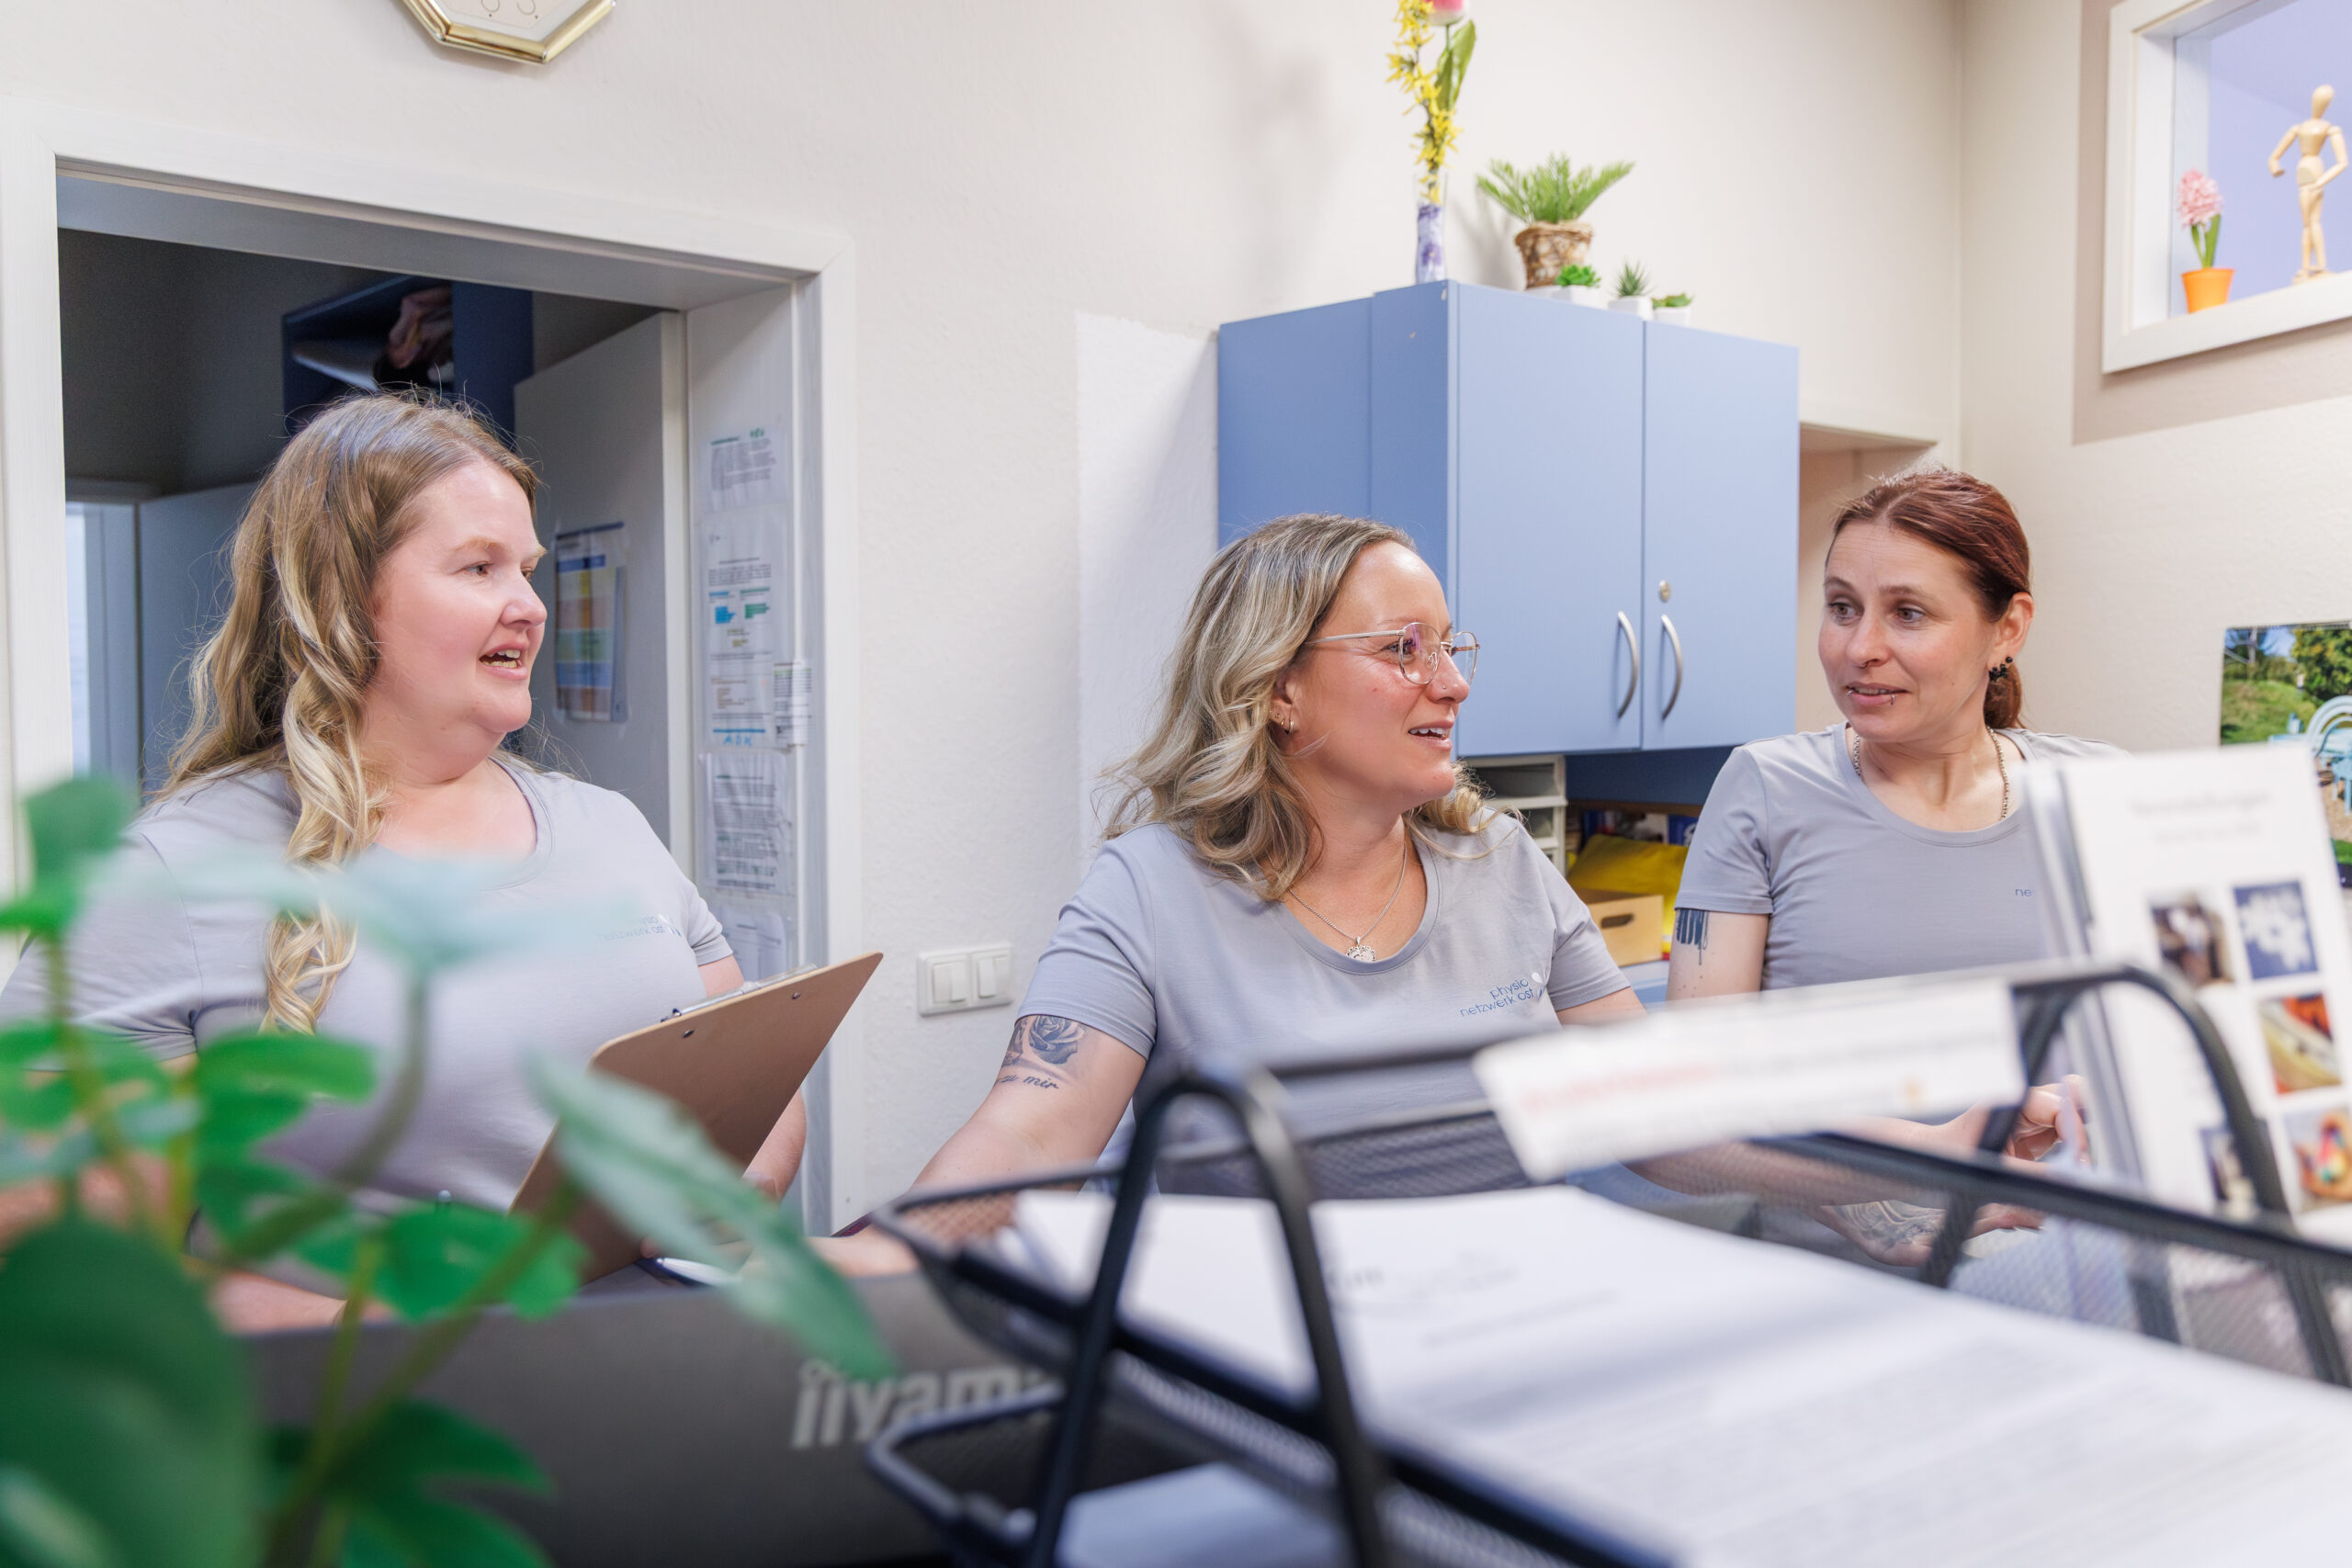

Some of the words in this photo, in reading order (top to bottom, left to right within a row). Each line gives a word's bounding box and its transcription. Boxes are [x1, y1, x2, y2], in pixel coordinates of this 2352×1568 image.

[1489, 977, 1529, 999] physio
[1460, 996, 1516, 1017] netzwerk
[1517, 987, 1534, 1001] ost
[1022, 1076, 1059, 1089] mir
